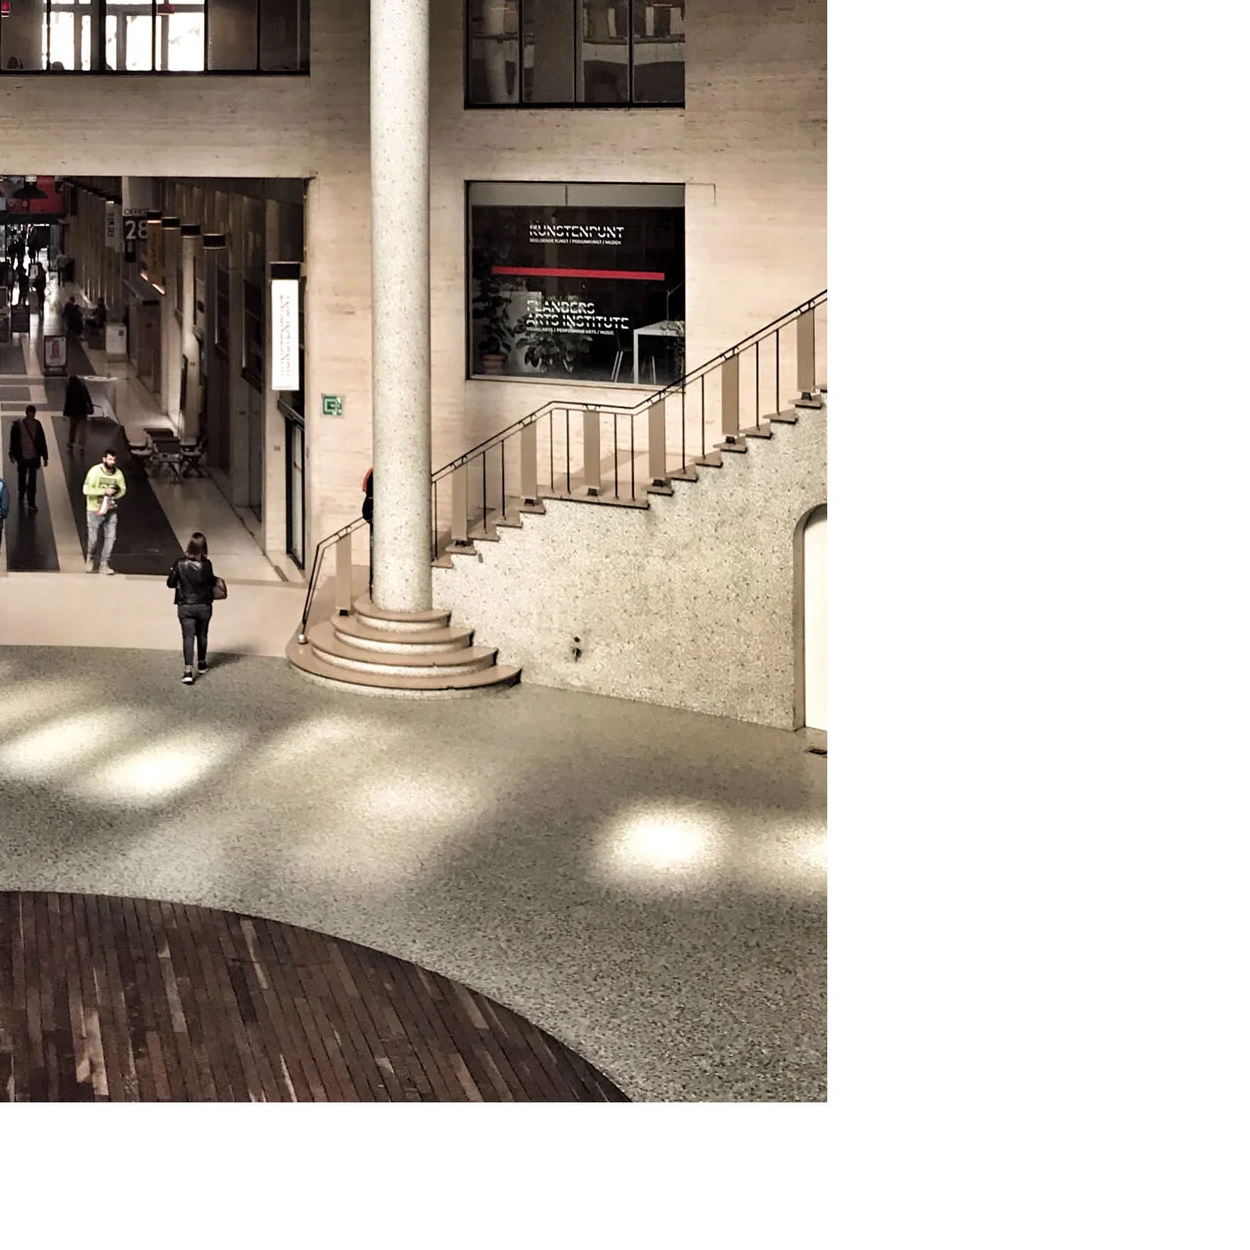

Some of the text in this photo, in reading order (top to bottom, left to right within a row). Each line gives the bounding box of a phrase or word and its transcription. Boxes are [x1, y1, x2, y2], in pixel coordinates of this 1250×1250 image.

[125, 219, 148, 240] 28
[529, 224, 625, 239] KUNSTENPUNT
[527, 300, 595, 314] FLANDERS
[526, 313, 629, 330] ARTS INSTITUTE
